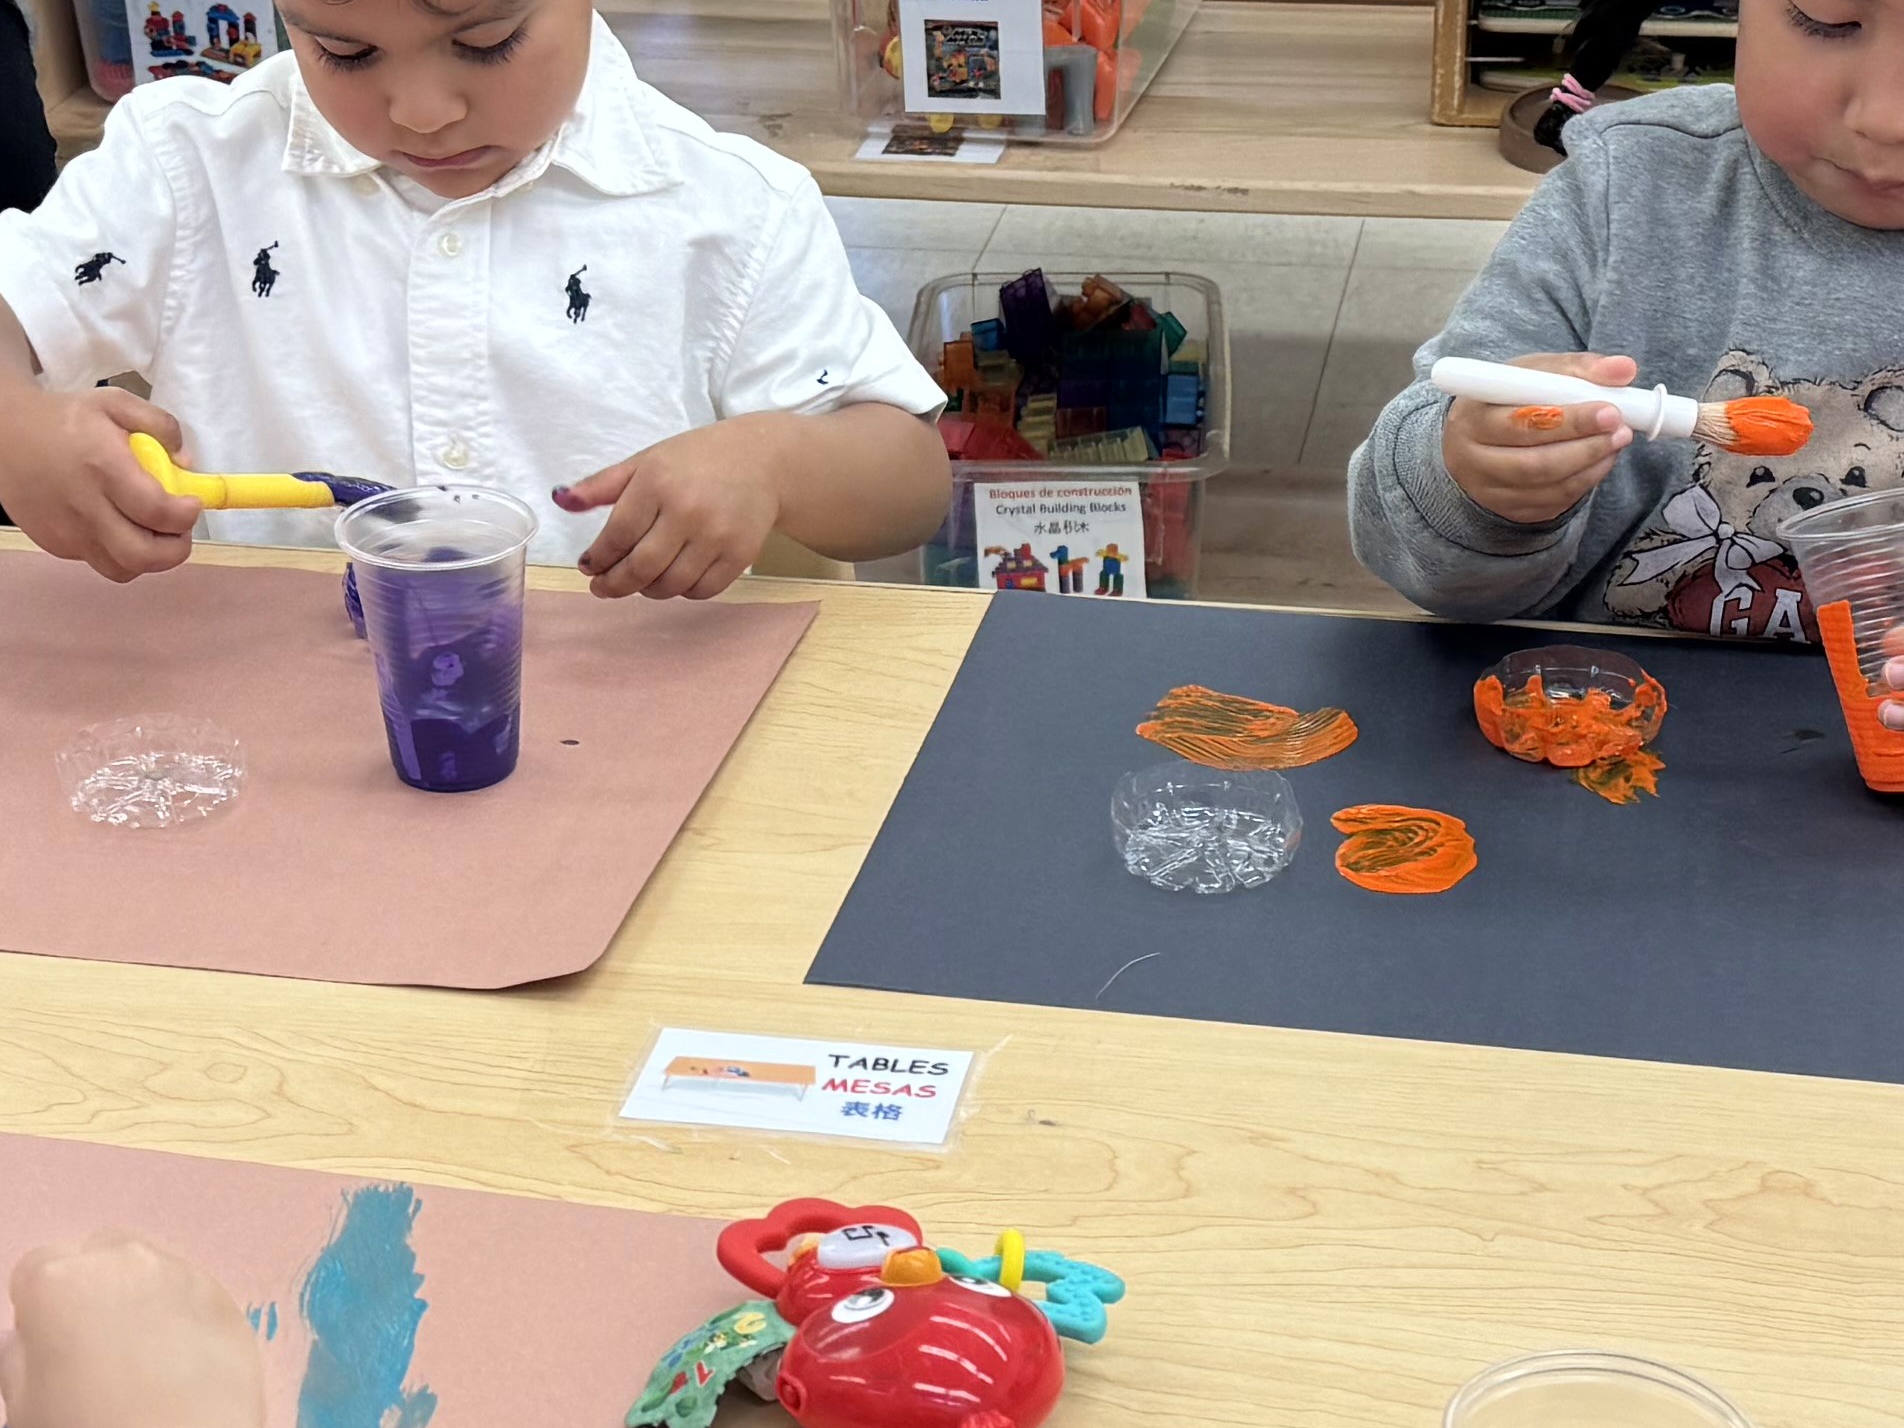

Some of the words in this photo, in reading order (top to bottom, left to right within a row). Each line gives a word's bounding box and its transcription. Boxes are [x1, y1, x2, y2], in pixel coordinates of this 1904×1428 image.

[990, 489, 1035, 500] Bloques
[1039, 486, 1053, 498] de
[1057, 485, 1132, 497] construcción
[996, 503, 1036, 517] Crystal
[1039, 502, 1086, 515] Building
[1089, 501, 1127, 513] Blocks
[828, 1054, 949, 1076] TABLES
[822, 1078, 937, 1099] MESAS
[841, 1101, 904, 1121] 表格
